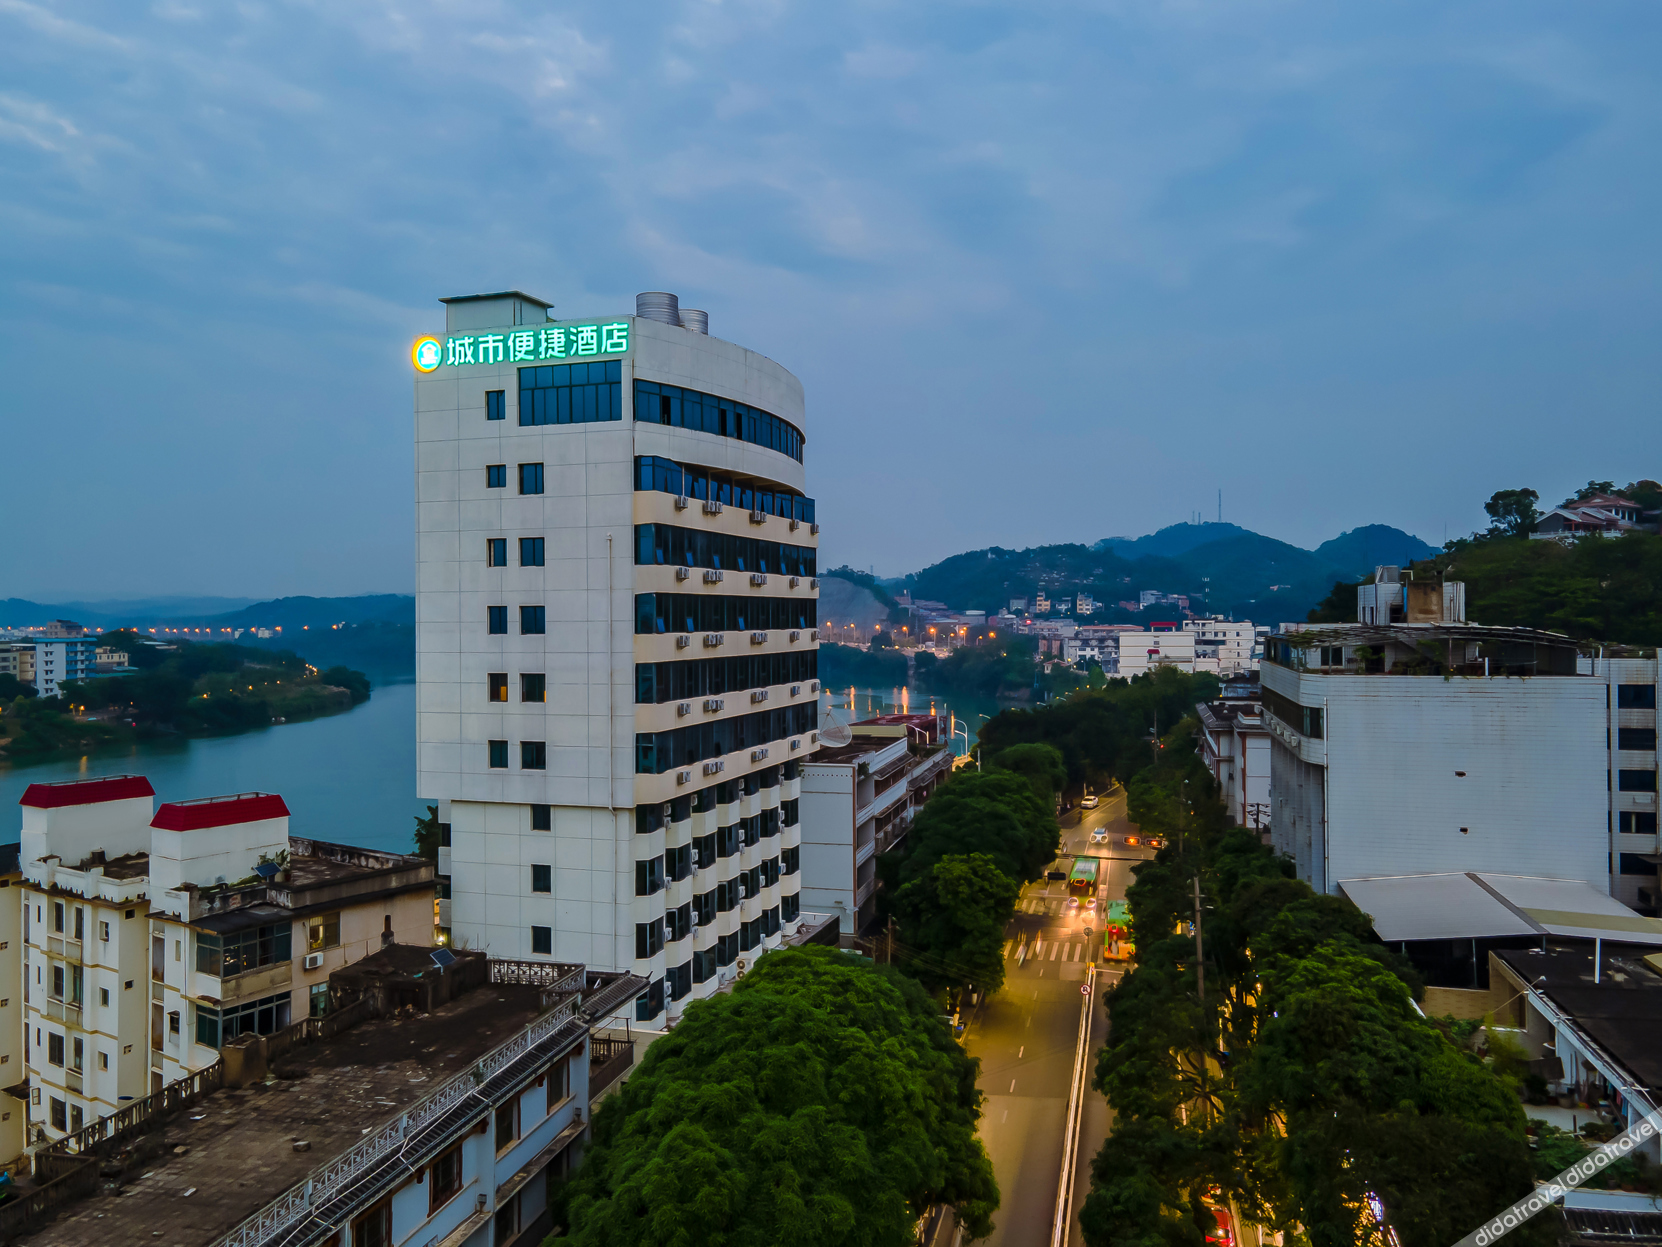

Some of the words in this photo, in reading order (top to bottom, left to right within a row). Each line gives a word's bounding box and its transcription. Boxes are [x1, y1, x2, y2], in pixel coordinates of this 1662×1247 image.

[446, 322, 629, 367] 城市便捷酒店
